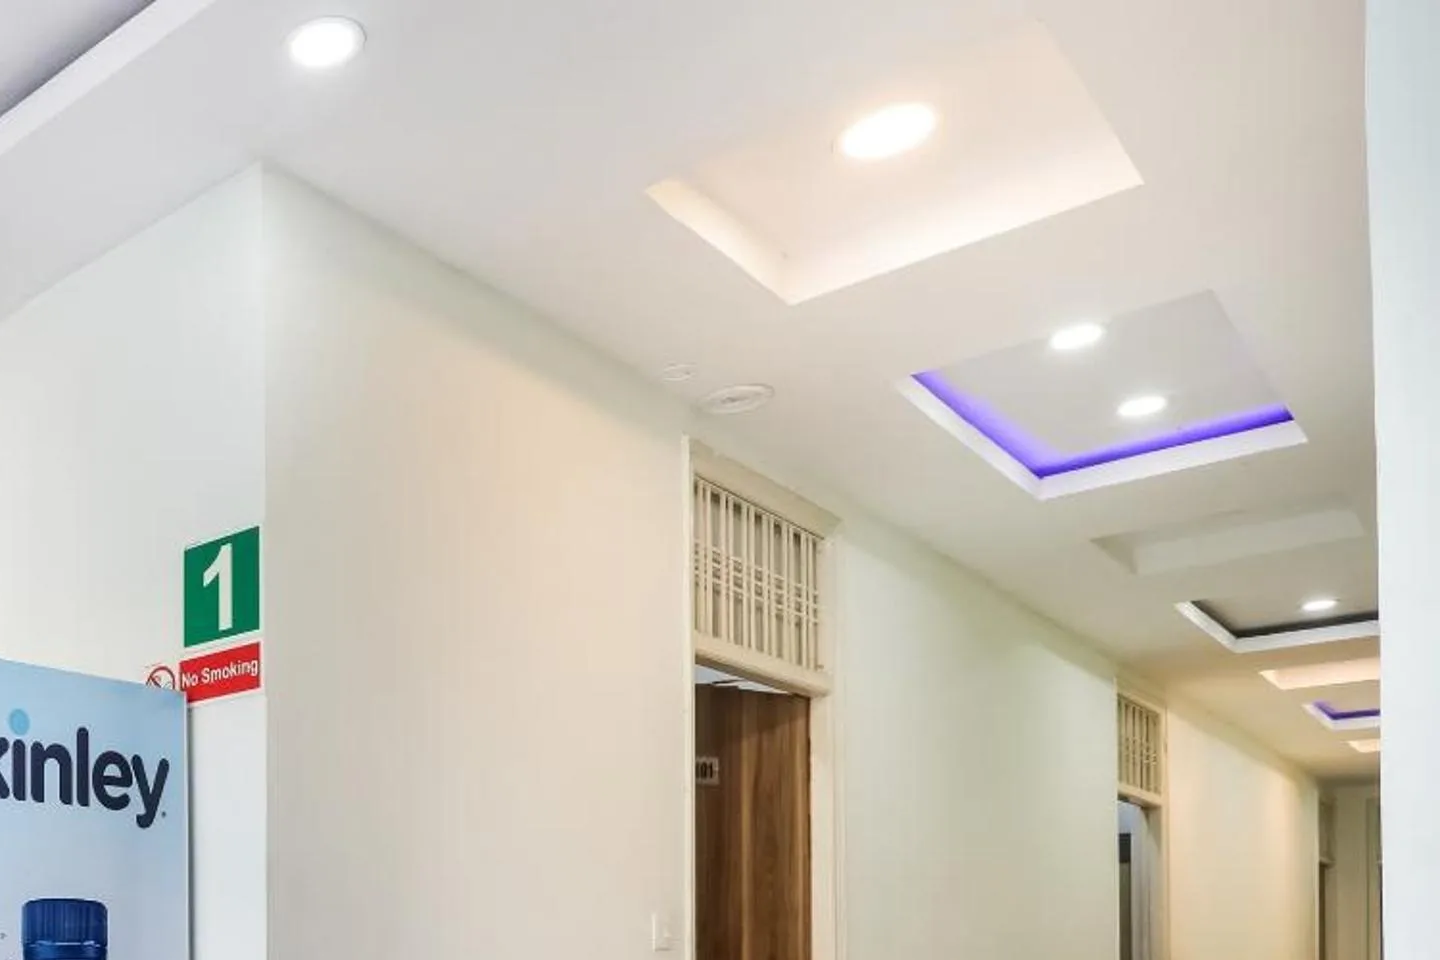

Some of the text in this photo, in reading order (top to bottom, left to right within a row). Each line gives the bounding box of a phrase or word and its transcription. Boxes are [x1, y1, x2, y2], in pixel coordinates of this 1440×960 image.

[203, 542, 234, 633] 1
[181, 659, 258, 690] No Smoking
